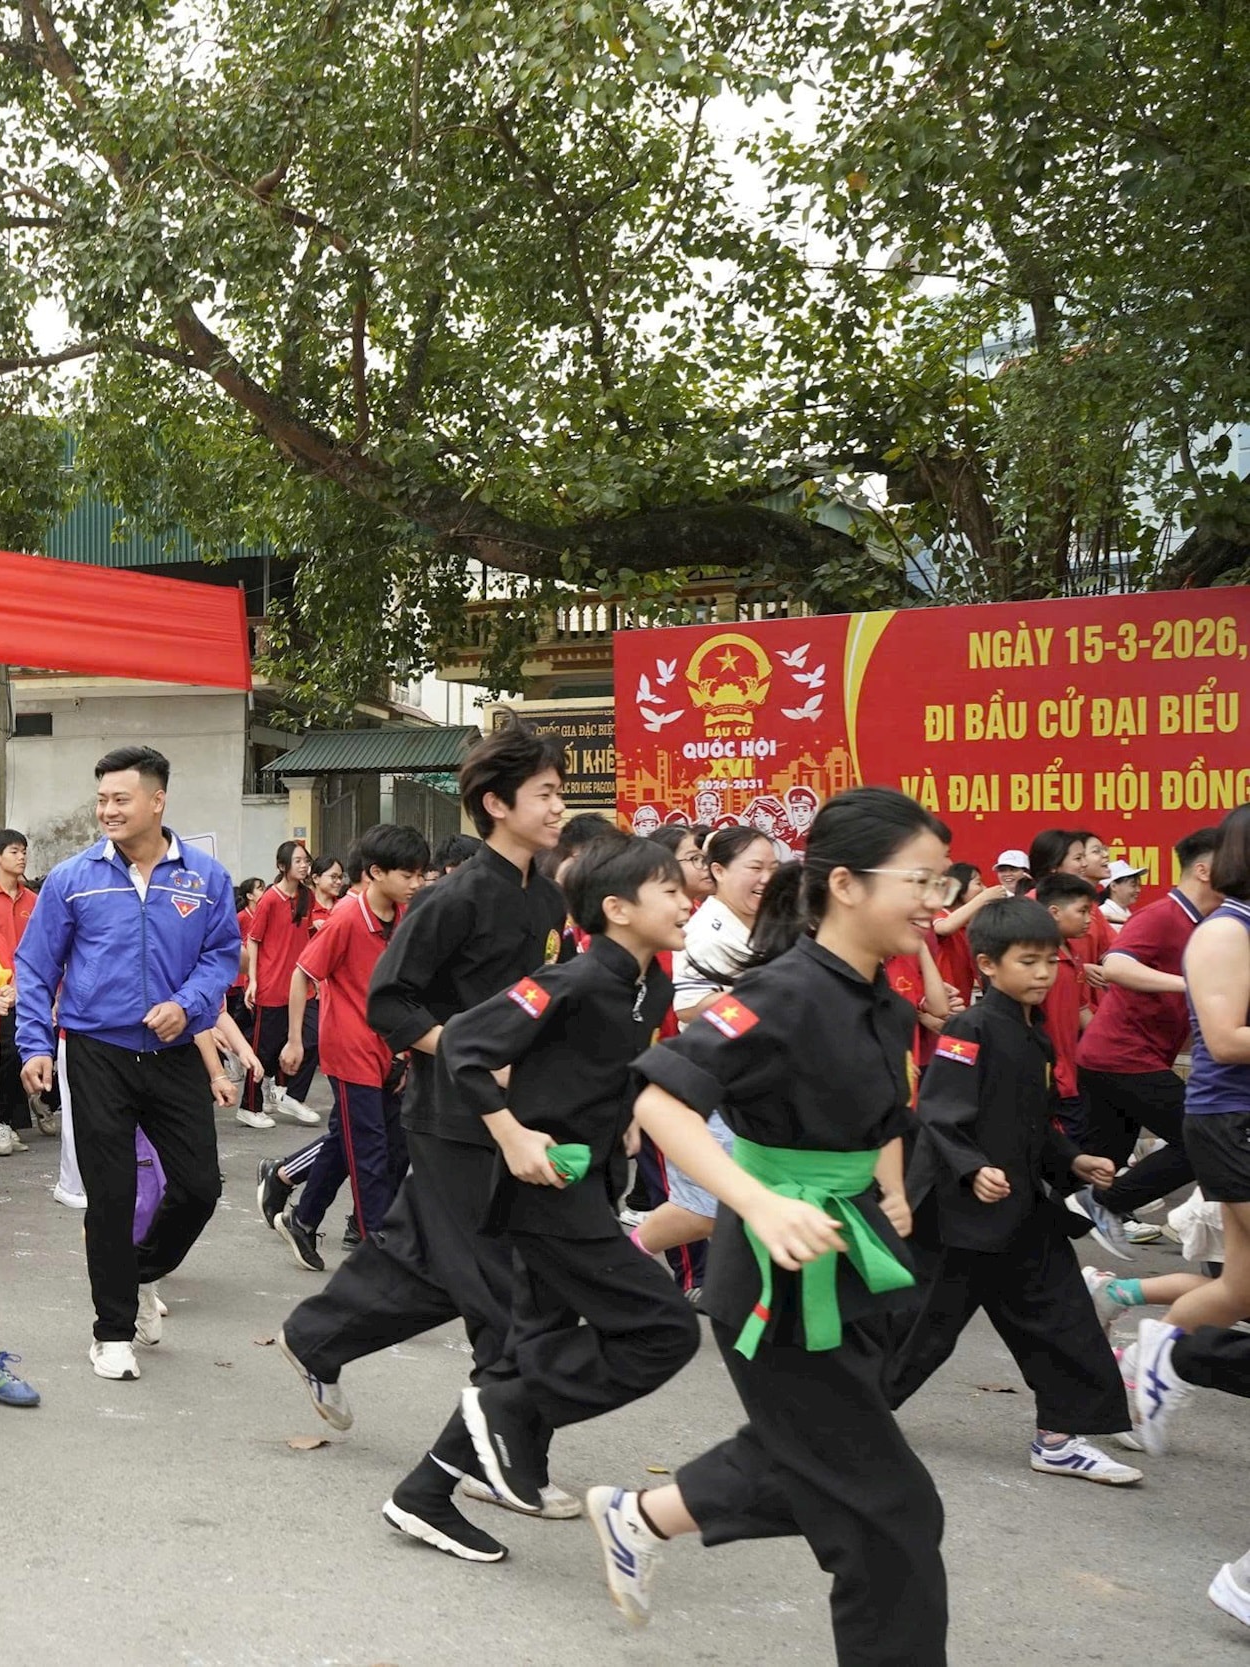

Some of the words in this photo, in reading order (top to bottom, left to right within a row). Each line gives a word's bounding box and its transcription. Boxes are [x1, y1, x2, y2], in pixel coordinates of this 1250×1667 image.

[968, 621, 1054, 669] NGÀY
[1064, 616, 1247, 665] 15-3-2026,
[924, 704, 955, 742] ĐI
[965, 689, 1028, 741] BẦU
[1038, 686, 1085, 739] CỬ
[1090, 696, 1147, 745] ĐẠI
[1159, 676, 1239, 735] BIỂU
[561, 725, 577, 737] GIA
[579, 721, 597, 739] ĐẶC
[582, 743, 616, 774] KHÊ
[682, 736, 736, 760] QUỐC
[740, 736, 777, 761] HỘI
[708, 758, 753, 779] XVI
[697, 778, 764, 790] 2026-2031
[900, 767, 941, 813] VÀ
[947, 774, 1000, 821] ĐẠI
[1010, 757, 1083, 812] BIỂU
[1094, 763, 1150, 820] HỘI
